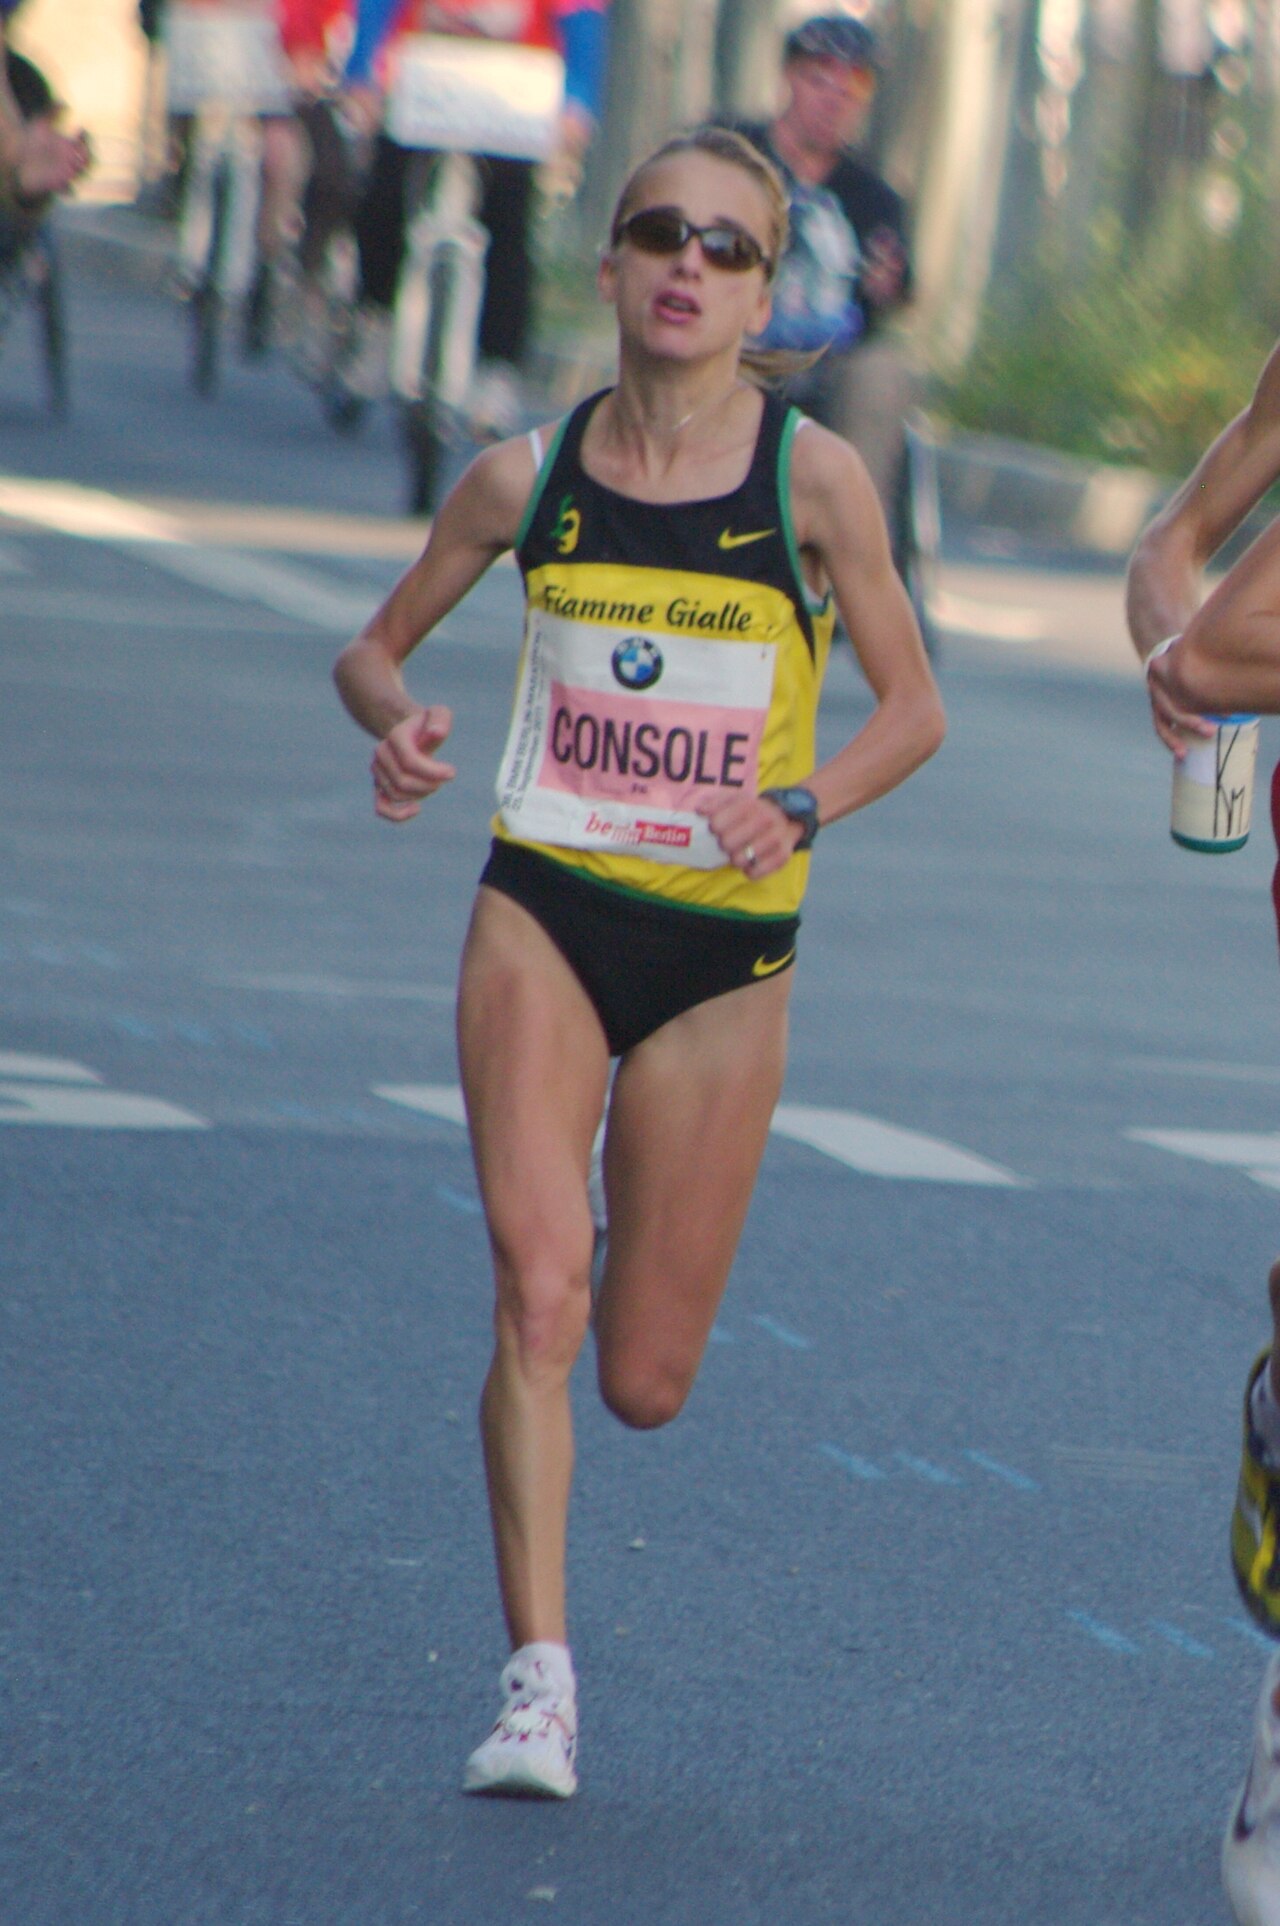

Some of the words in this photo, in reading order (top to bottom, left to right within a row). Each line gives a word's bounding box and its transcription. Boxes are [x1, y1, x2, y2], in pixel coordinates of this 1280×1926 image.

[543, 585, 654, 624] Fiamme
[666, 597, 752, 631] Gialle
[552, 705, 749, 788] CONSOLE
[585, 811, 613, 836] be
